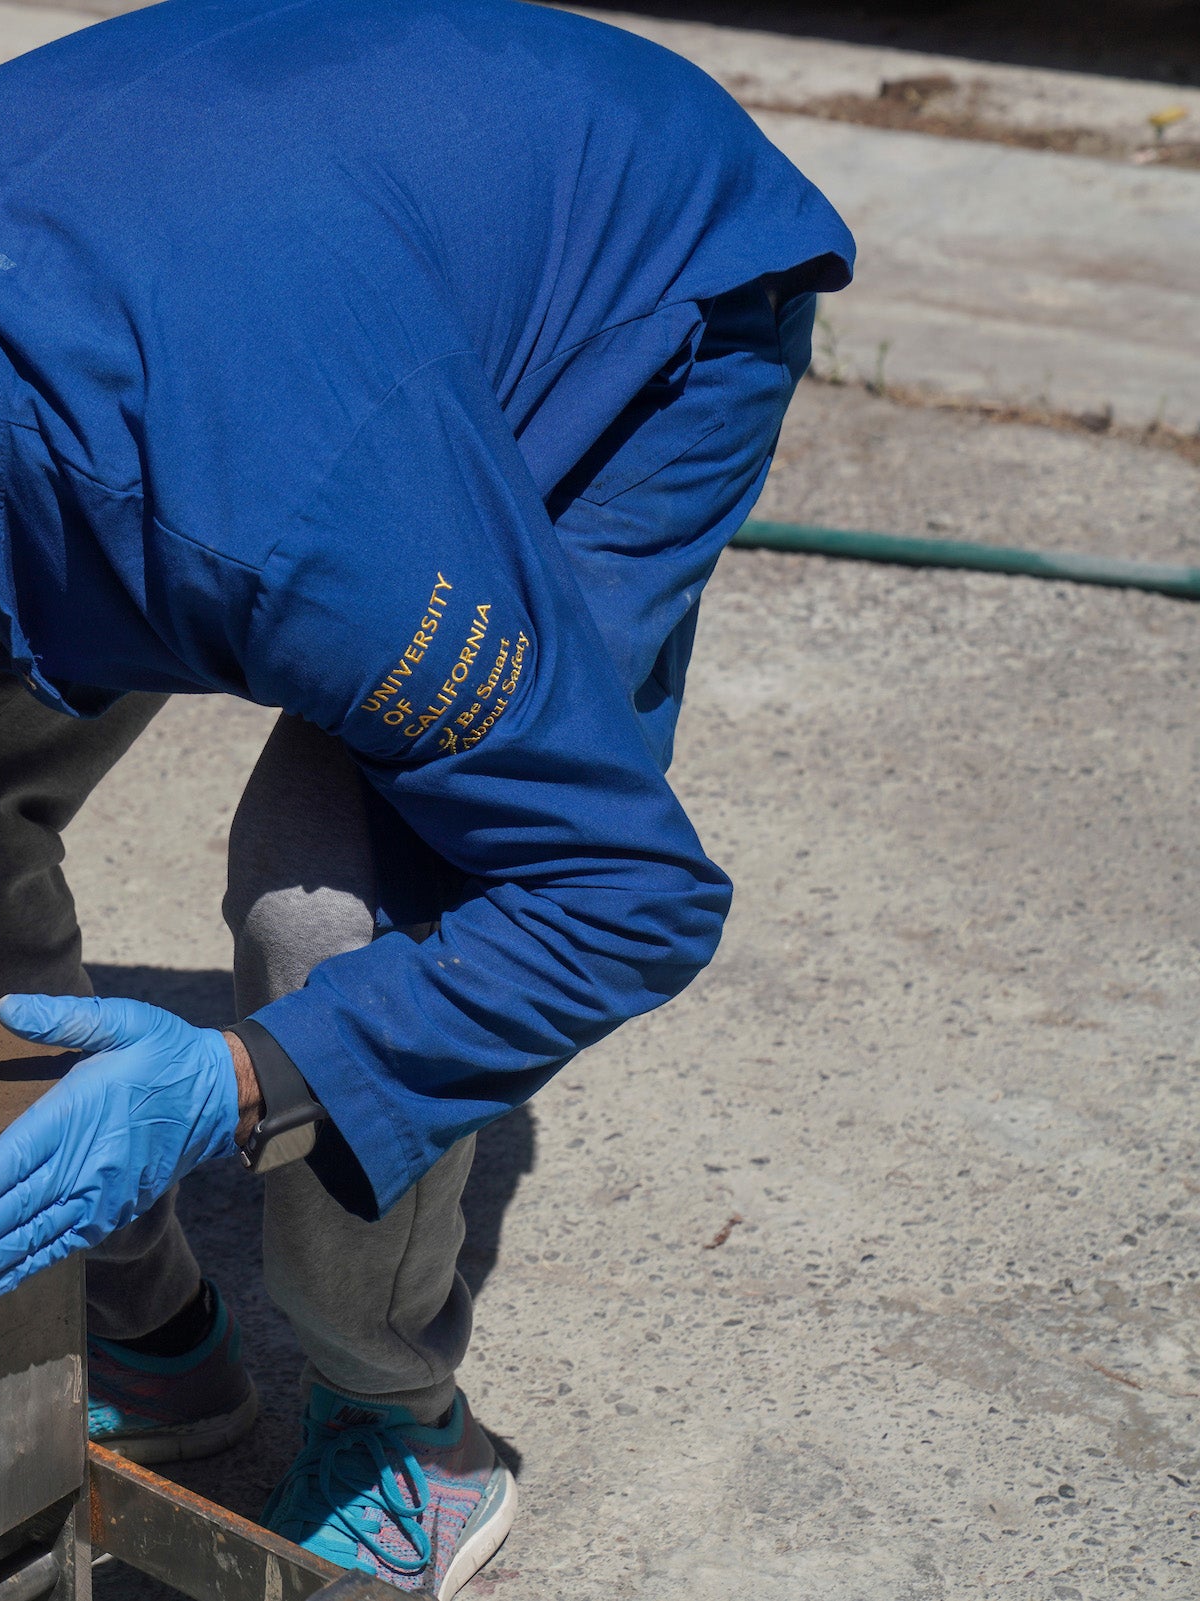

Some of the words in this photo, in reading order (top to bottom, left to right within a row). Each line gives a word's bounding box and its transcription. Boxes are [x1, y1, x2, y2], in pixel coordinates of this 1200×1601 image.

[361, 571, 453, 712] UNIVERSITY
[404, 604, 491, 737] CALIFORNIA
[455, 702, 481, 729] Be
[476, 637, 510, 700] Smart
[463, 697, 509, 750] About
[502, 631, 530, 695] Safety
[383, 698, 413, 726] OF
